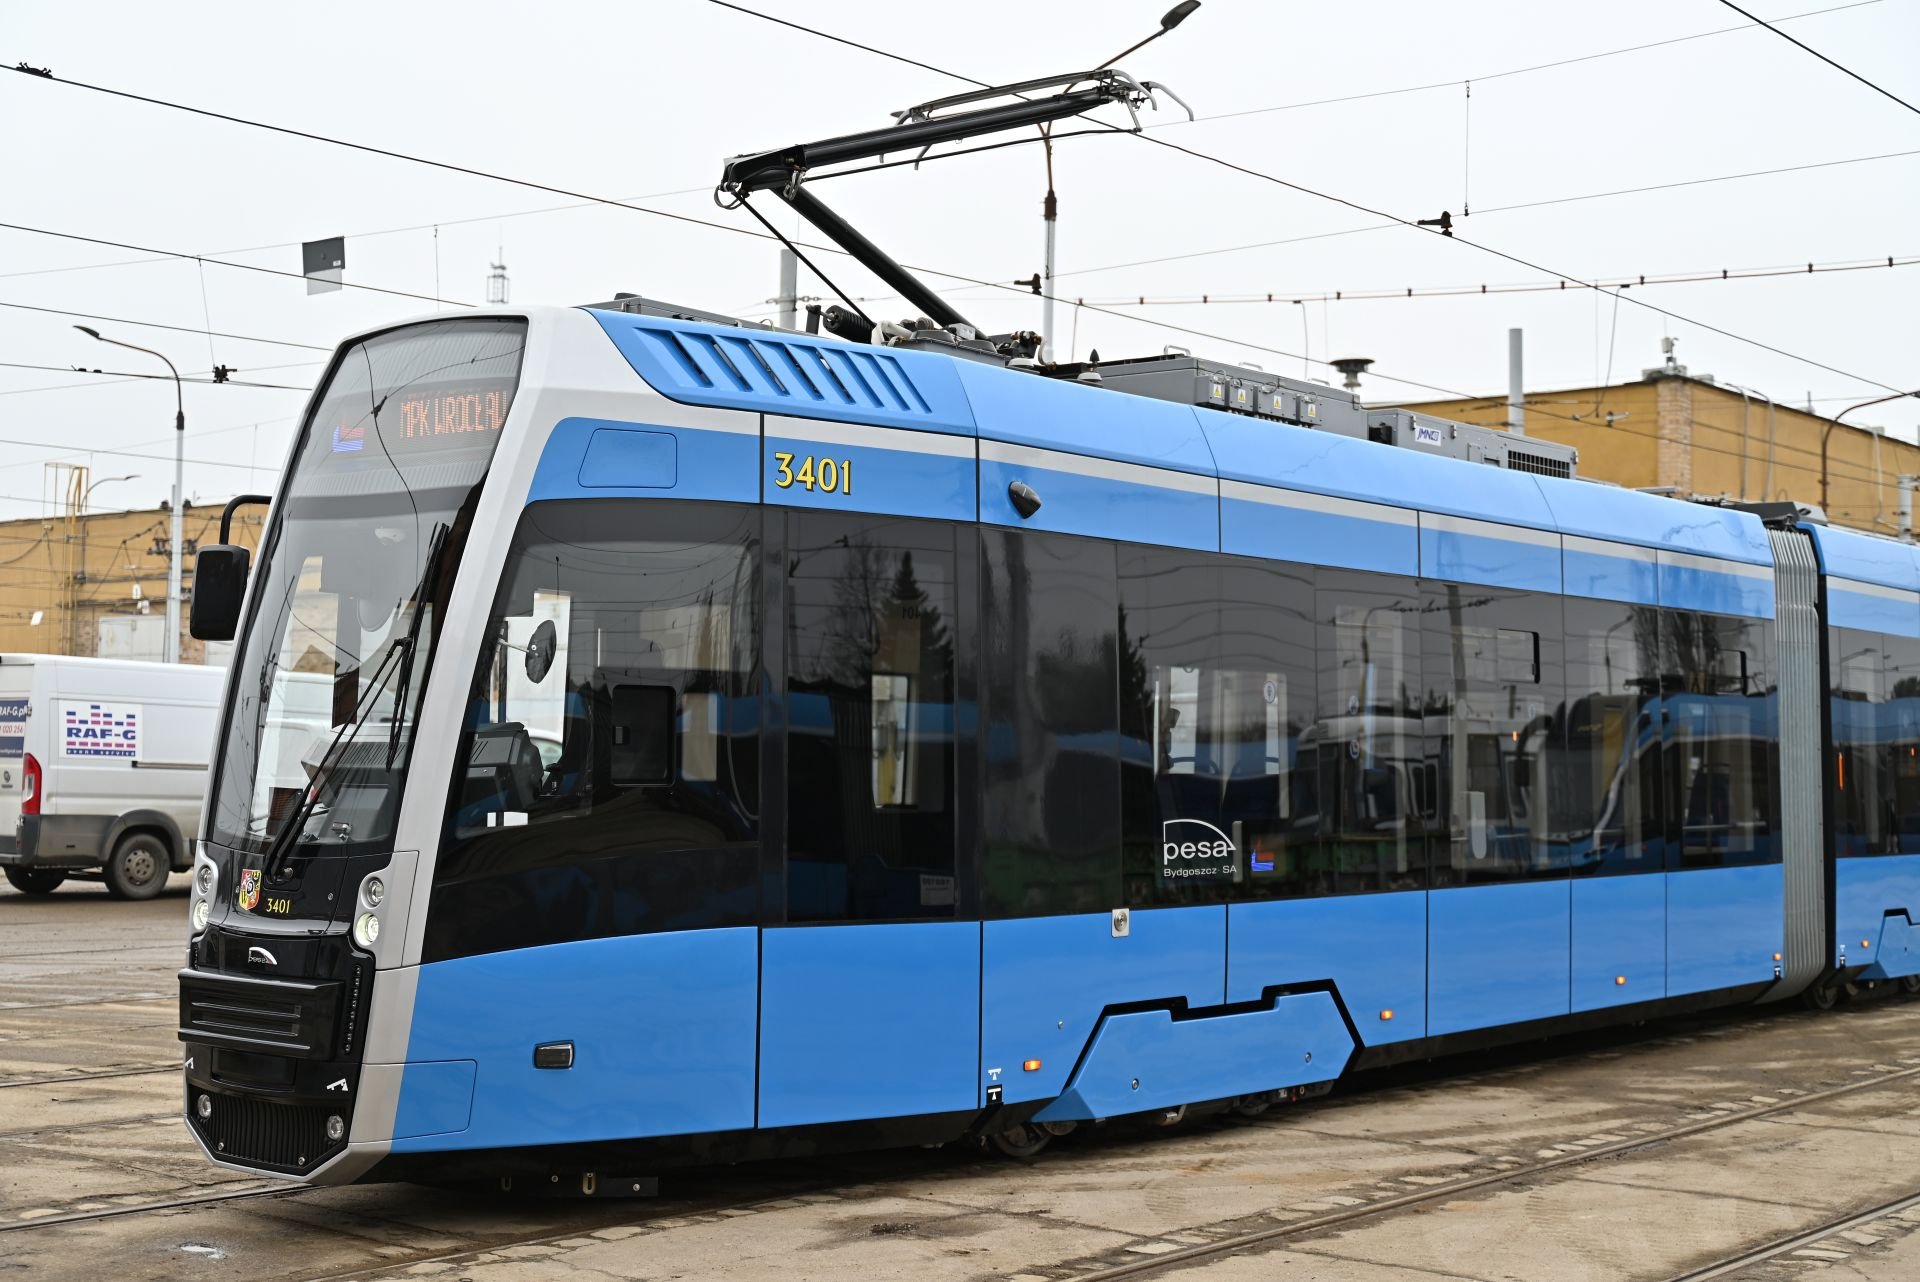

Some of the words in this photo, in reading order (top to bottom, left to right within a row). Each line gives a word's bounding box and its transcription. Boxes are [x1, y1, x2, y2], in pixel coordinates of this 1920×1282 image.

[775, 452, 851, 495] 3401
[66, 727, 136, 740] RAF-G
[1163, 841, 1228, 865] pesa
[1163, 867, 1217, 877] Bydgoszcz
[1222, 865, 1237, 873] SA
[266, 898, 290, 914] 3401
